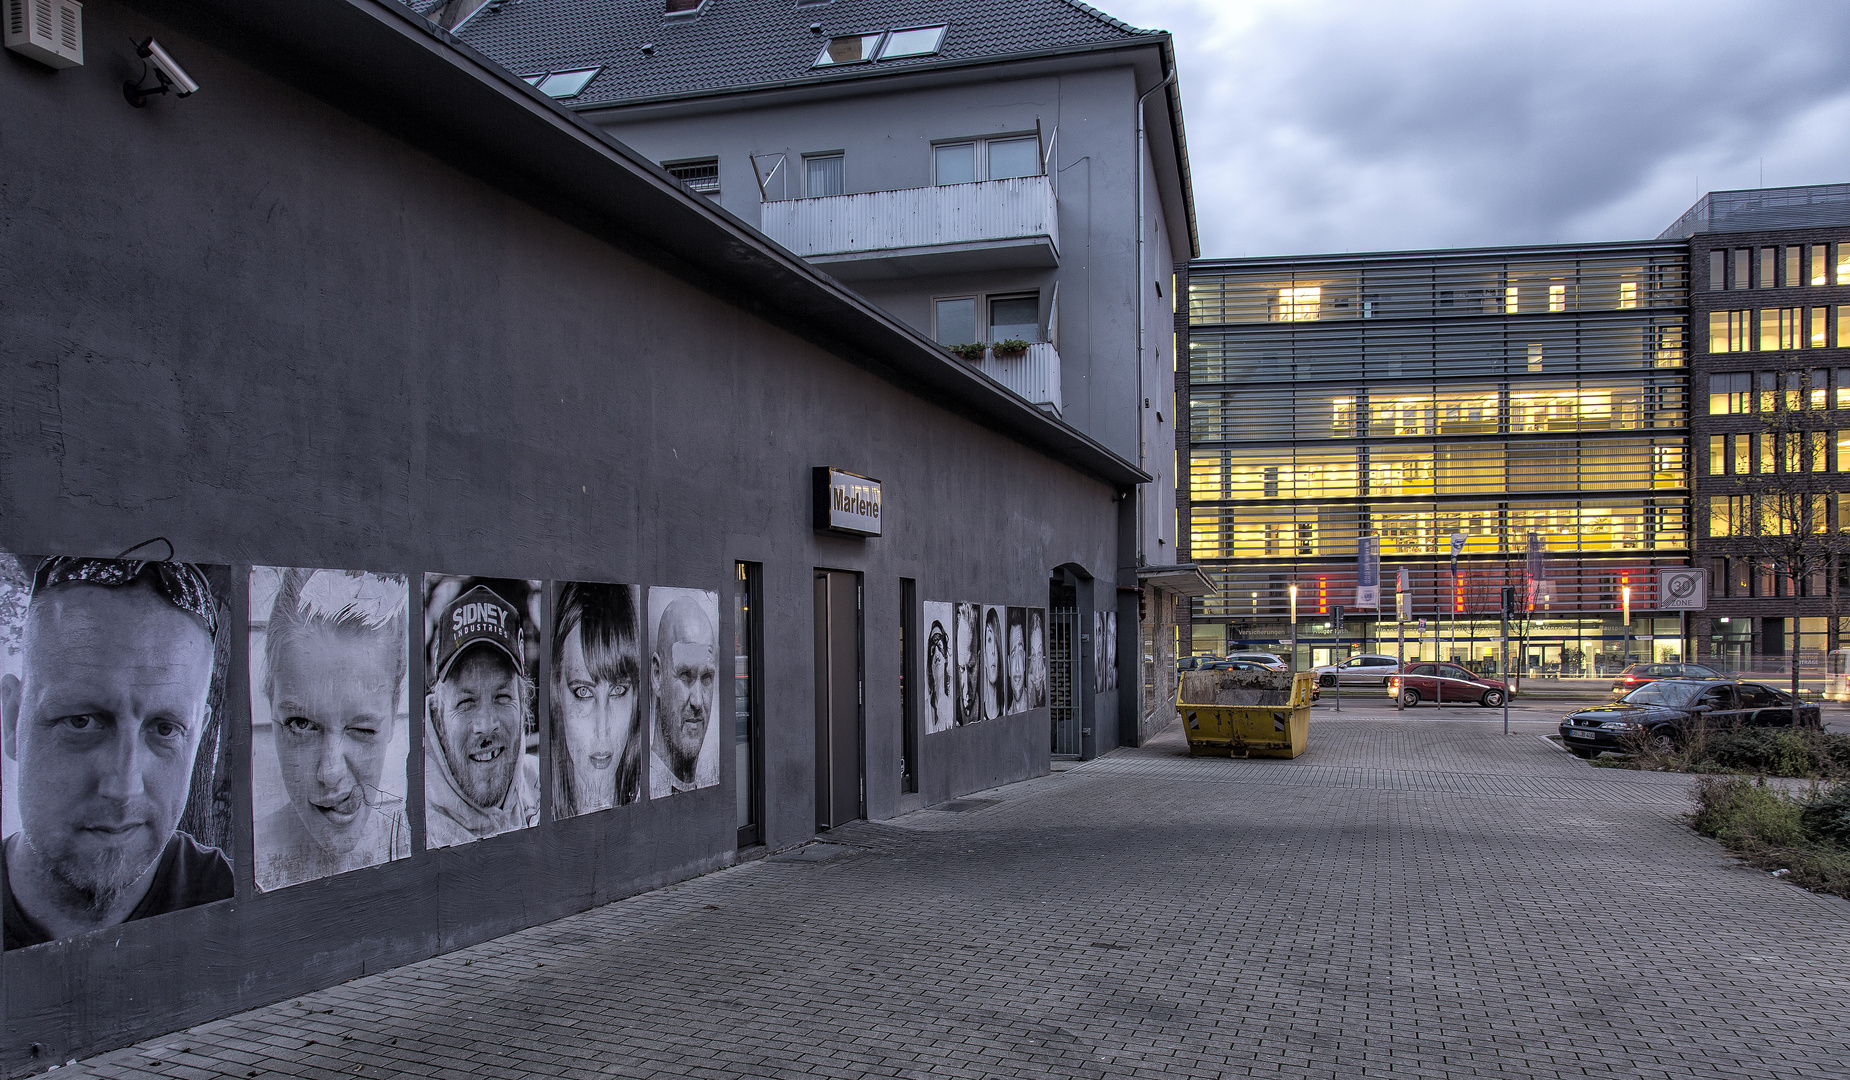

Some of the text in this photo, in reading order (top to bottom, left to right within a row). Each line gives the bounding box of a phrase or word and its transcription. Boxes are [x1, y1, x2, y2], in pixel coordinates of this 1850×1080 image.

[833, 487, 879, 519] Marlene
[1673, 580, 1690, 592] 30
[452, 602, 508, 631] SIDNEY
[453, 623, 508, 641] INDUSTRIES
